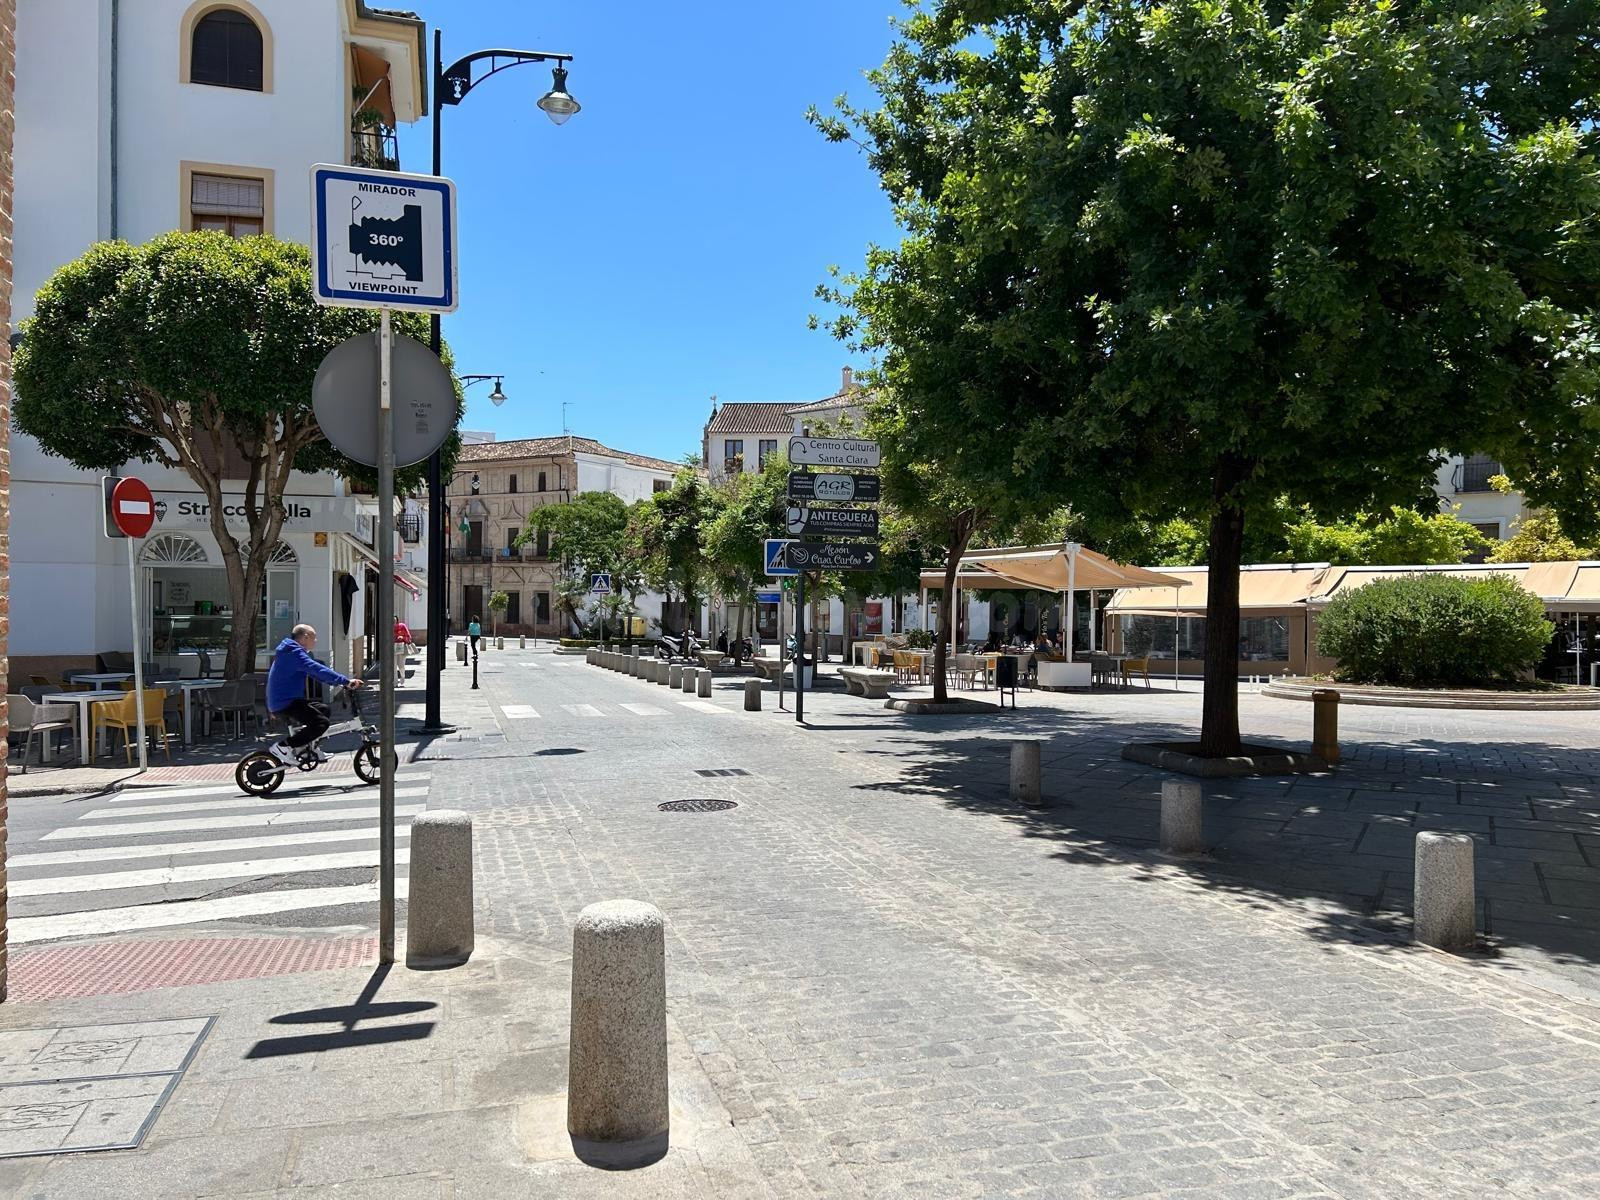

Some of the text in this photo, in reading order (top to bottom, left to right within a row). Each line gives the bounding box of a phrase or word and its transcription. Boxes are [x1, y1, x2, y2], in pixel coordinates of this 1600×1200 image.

[358, 183, 416, 198] MIRADOR
[348, 281, 419, 295] VIEWPOINT
[810, 440, 877, 452] Centro Cultural
[818, 453, 869, 464] Santa Clara
[818, 480, 851, 490] AGR
[810, 511, 875, 523] ANTEQUERA
[819, 544, 850, 556] Mesón
[811, 553, 862, 565] Casa Carlos
